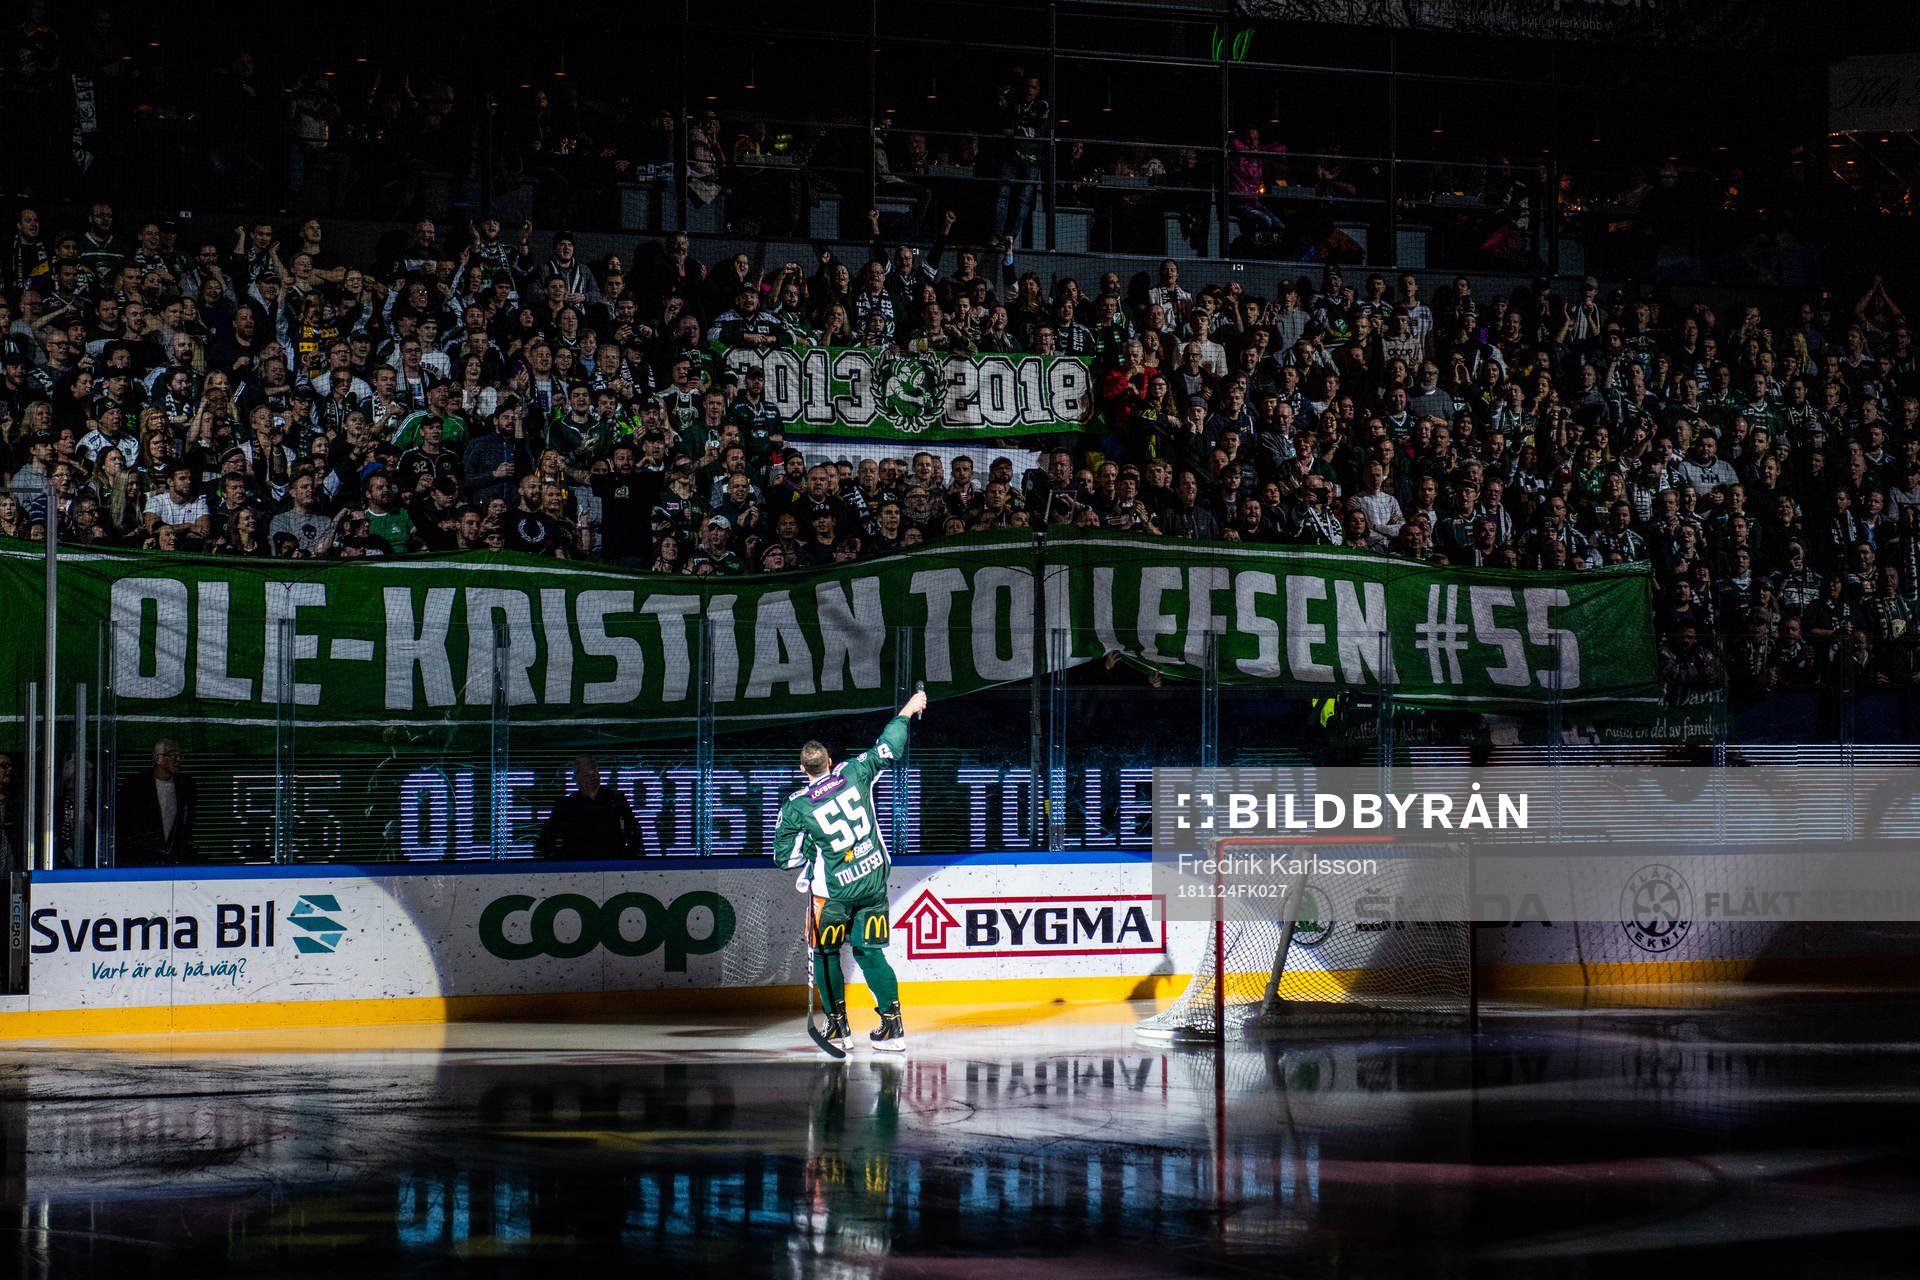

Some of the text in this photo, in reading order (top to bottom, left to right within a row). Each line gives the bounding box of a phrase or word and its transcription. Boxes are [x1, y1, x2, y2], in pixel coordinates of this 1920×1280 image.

[722, 346, 877, 425] 2013
[941, 355, 1094, 427] 2018
[109, 564, 1582, 712] OLE-KRISTIAN TOLLEFSEN #55
[812, 786, 872, 853] 55
[13, 901, 21, 948] ICEPRO
[30, 900, 275, 954] Svema Bil
[965, 906, 1155, 947] BYGMA
[1704, 886, 1802, 917] FLÄKT
[478, 890, 738, 972] coop
[1625, 919, 1689, 949] TEKNIK
[91, 962, 126, 981] Vart
[132, 959, 152, 979] är
[156, 960, 178, 979] du
